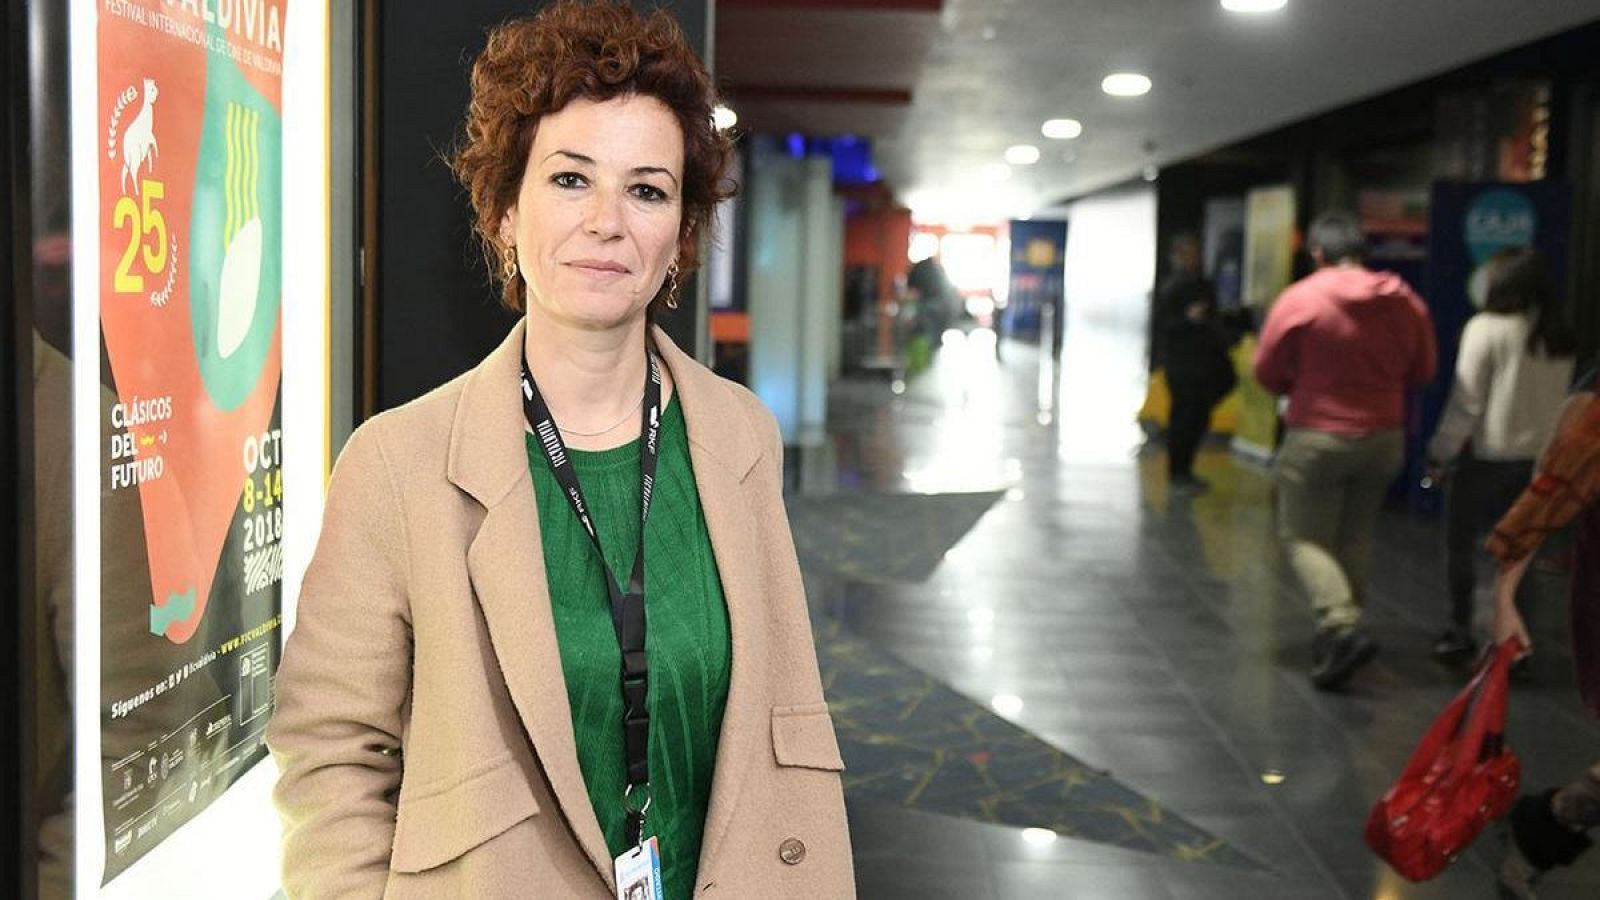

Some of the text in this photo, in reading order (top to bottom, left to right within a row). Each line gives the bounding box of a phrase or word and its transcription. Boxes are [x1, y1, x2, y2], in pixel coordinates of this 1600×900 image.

[105, 1, 148, 27] FESTIVAL
[113, 179, 167, 293] 25
[111, 395, 172, 429] CLÁSICOS
[111, 432, 139, 460] DEL
[243, 429, 281, 474] OCT
[111, 456, 164, 489] FUTURO
[243, 468, 281, 511] 8-14
[243, 507, 281, 553] 2018
